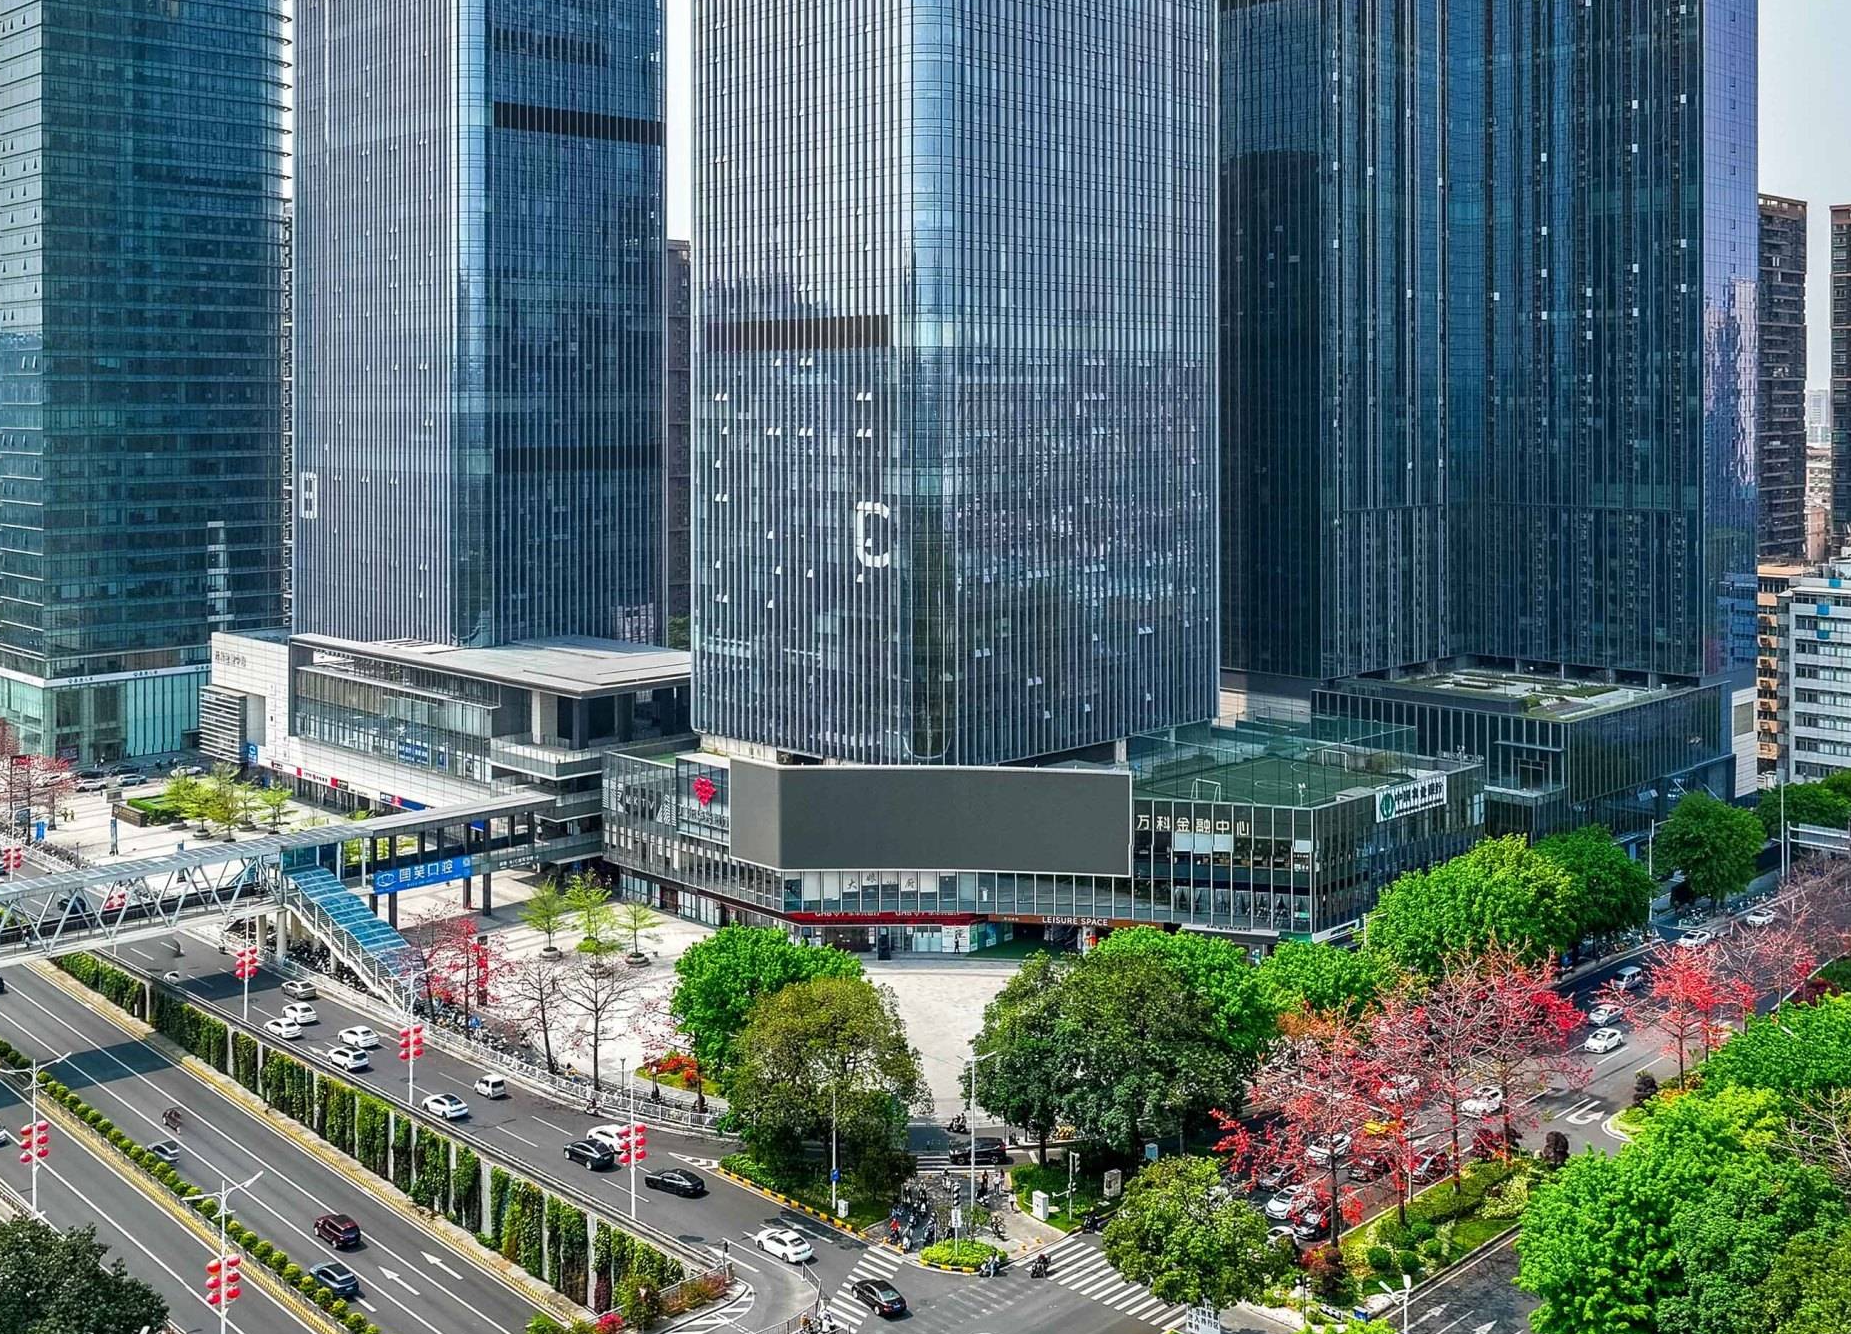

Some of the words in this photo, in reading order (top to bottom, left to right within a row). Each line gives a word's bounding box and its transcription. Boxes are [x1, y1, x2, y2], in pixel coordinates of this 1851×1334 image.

[1136, 814, 1250, 837] 万科金融中心
[1042, 916, 1078, 925] LEISURE
[1081, 917, 1108, 927] SPACE
